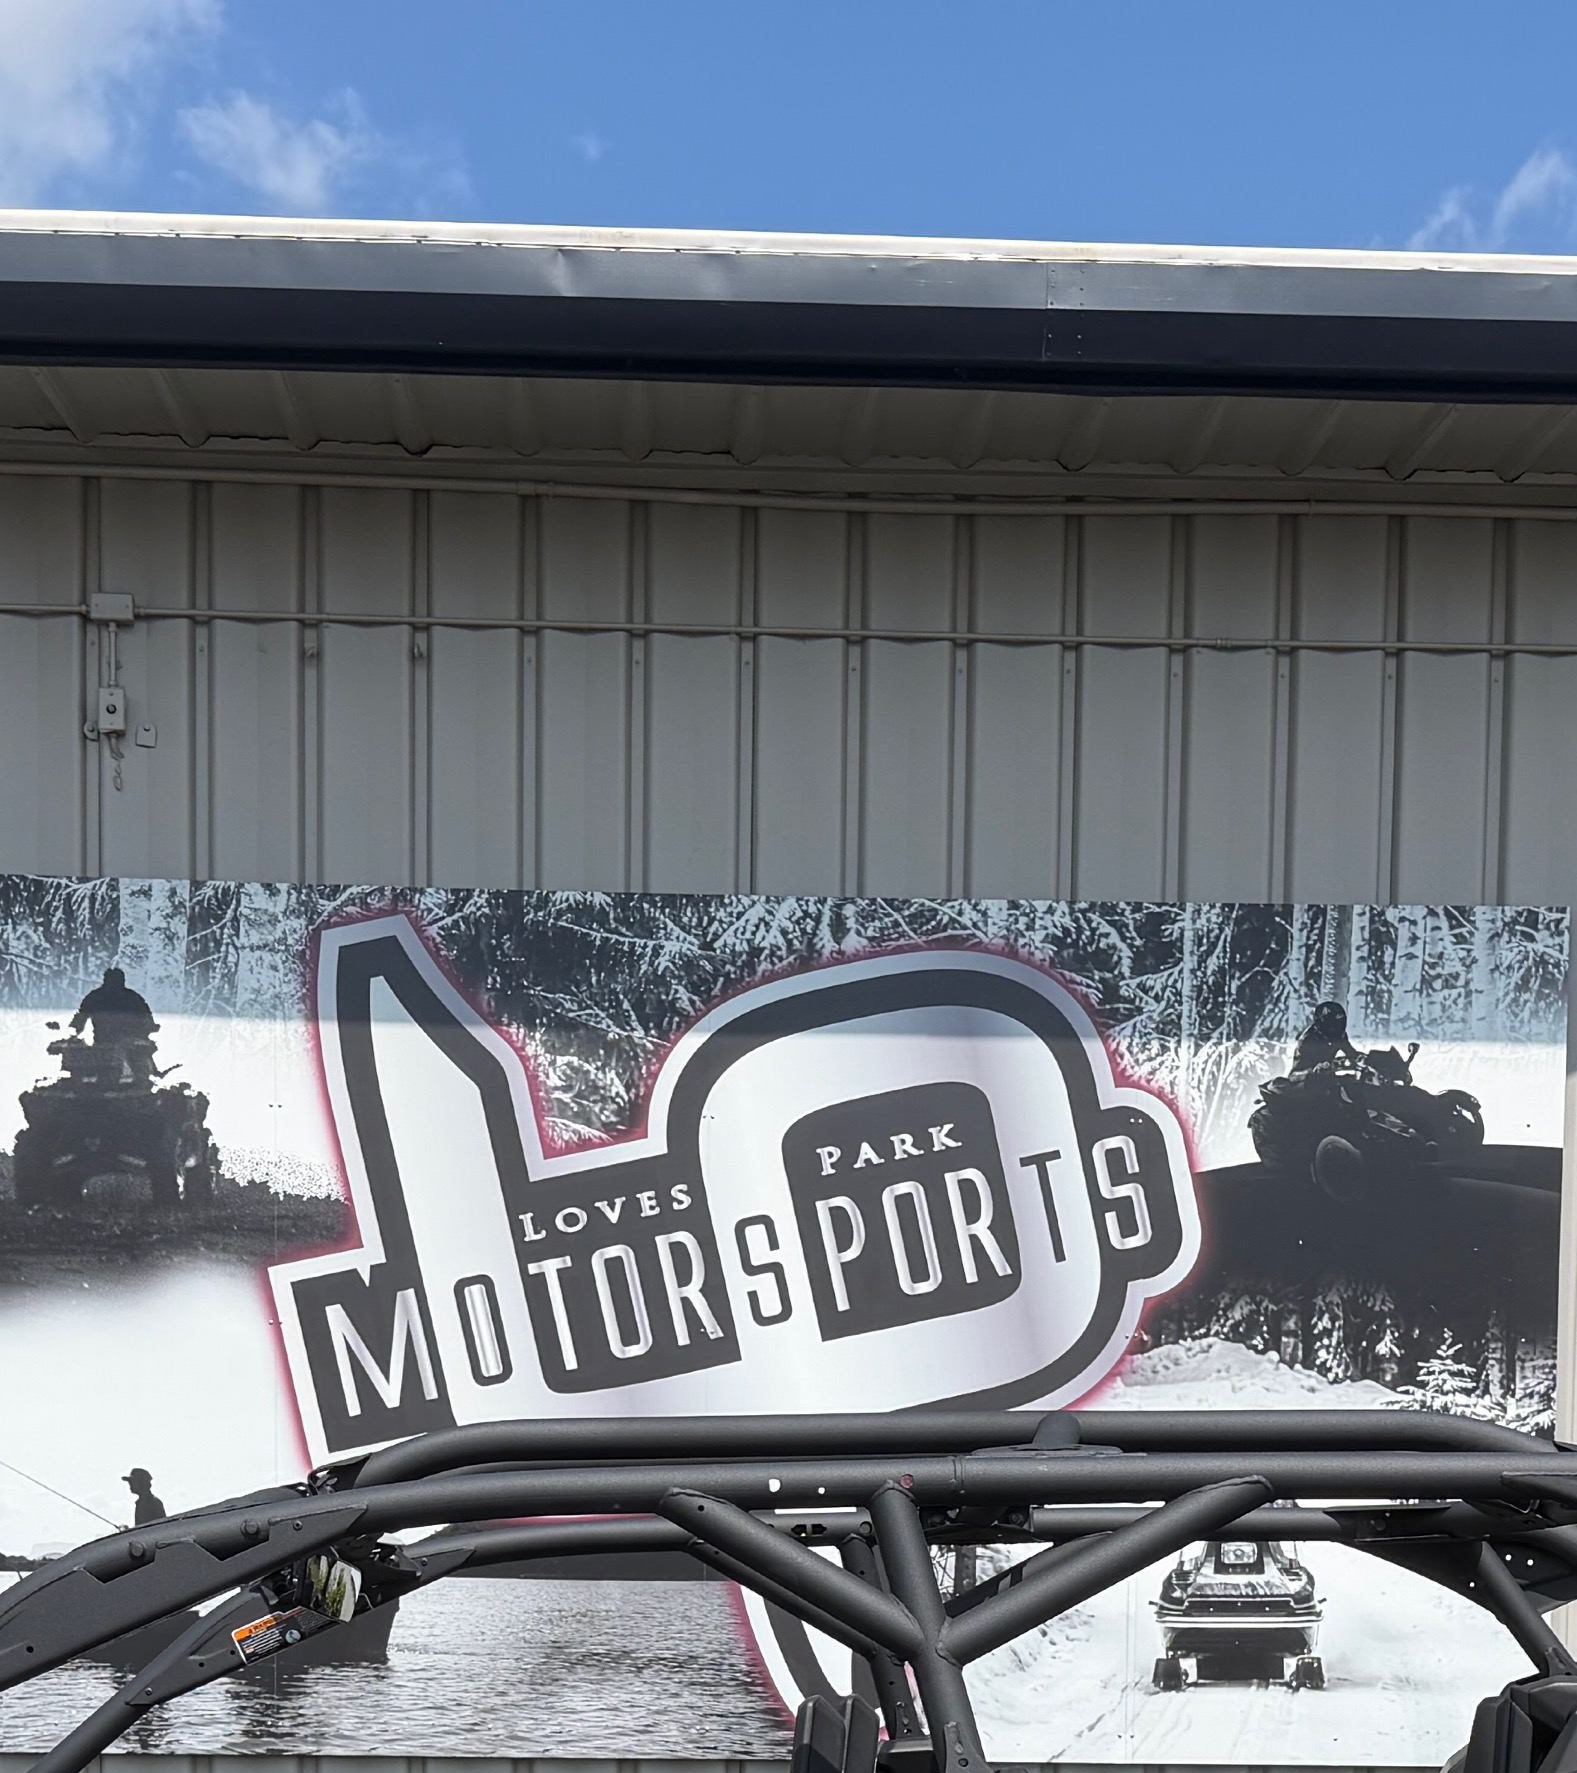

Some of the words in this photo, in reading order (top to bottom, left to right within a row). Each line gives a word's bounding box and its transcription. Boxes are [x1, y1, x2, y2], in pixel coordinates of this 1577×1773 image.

[324, 1134, 1154, 1418] MOTORSPORTS
[519, 1184, 692, 1241] LOVES
[816, 1123, 962, 1176] PARK
